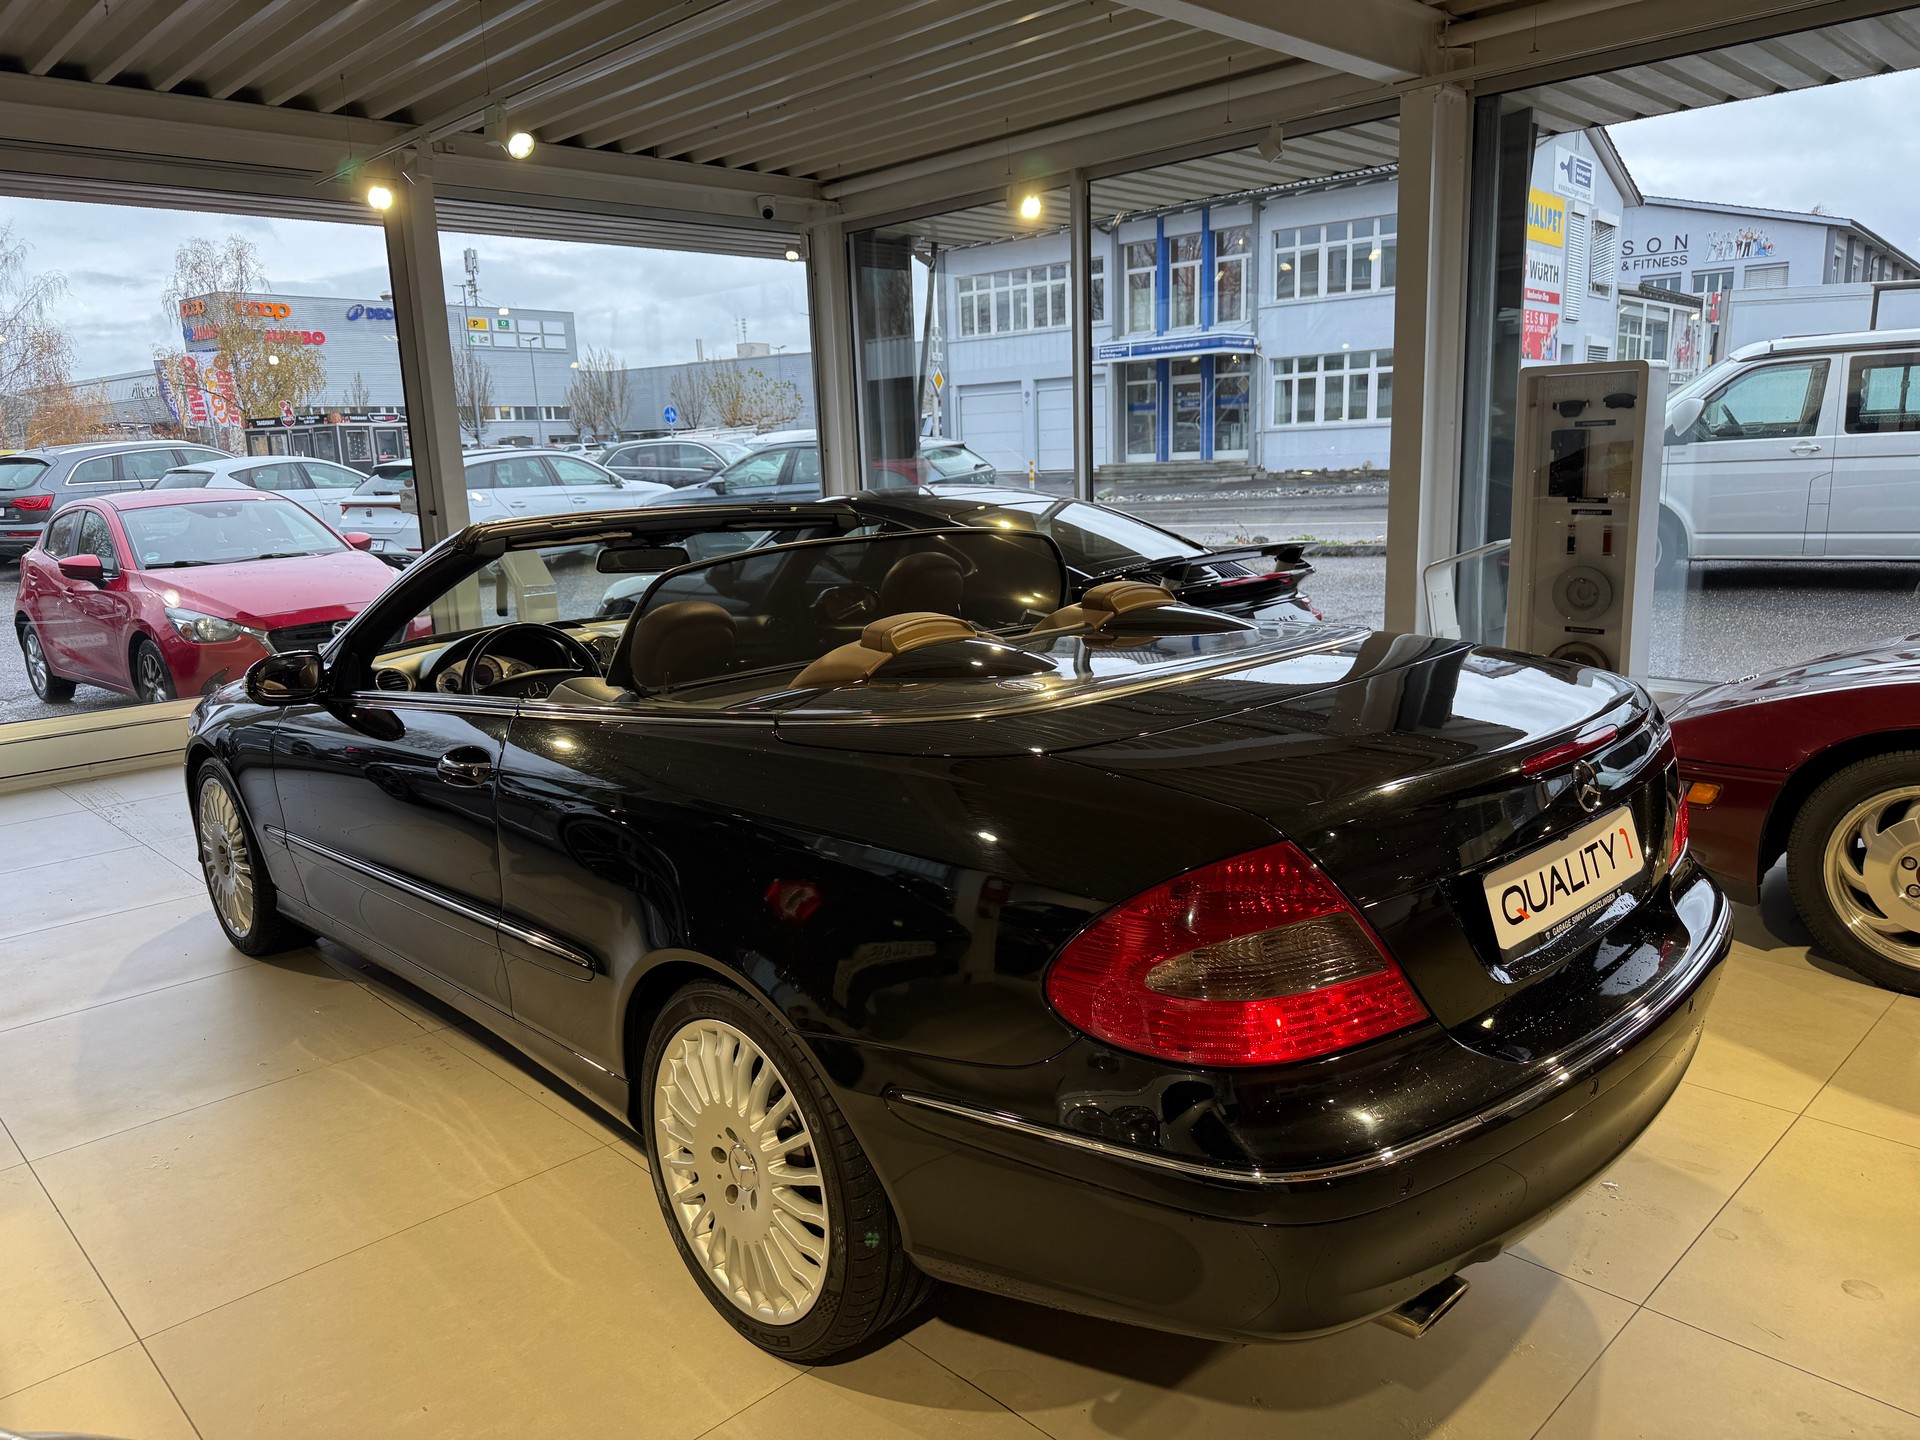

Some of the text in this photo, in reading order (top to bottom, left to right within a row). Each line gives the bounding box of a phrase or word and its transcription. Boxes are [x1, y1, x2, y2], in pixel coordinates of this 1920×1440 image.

[1621, 254, 1688, 271] & FITNESS
[1525, 310, 1549, 326] ELSON
[1552, 892, 1616, 936] GARAGE SIMON KREUZLINGEN
